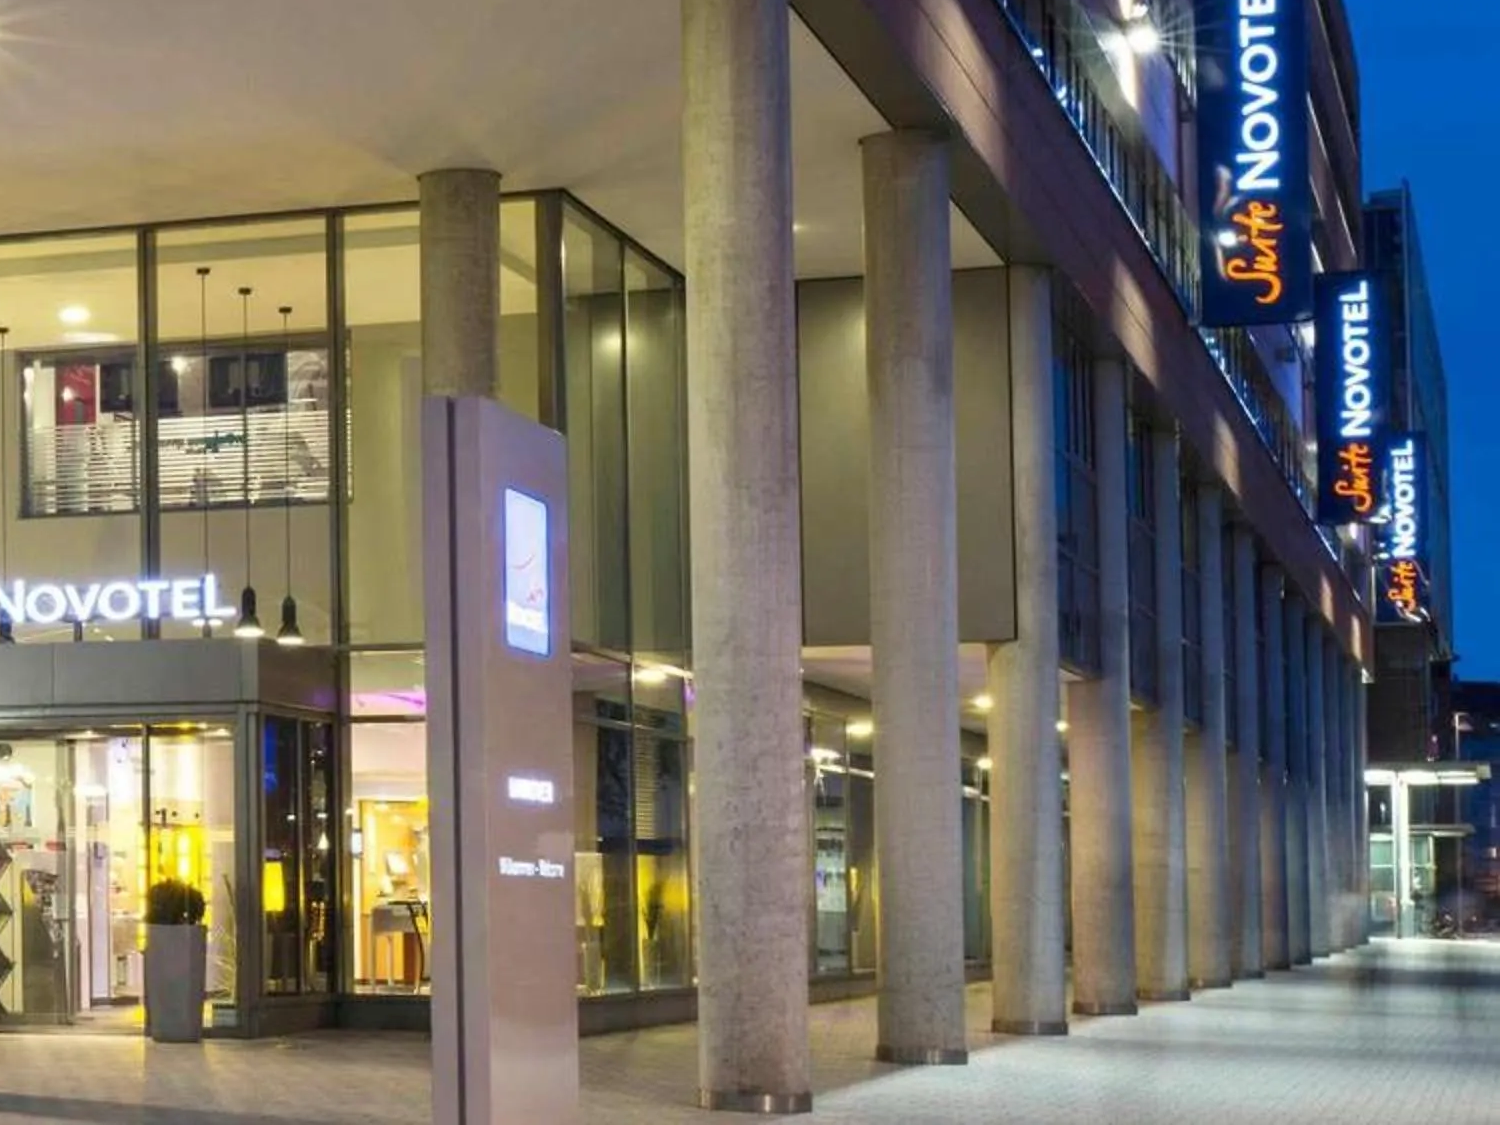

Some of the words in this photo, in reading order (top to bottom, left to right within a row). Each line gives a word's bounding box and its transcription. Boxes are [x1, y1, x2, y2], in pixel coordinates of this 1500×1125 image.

[1225, 201, 1283, 305] Suite
[1338, 280, 1371, 438] NOVOTEL
[1334, 442, 1373, 512] Suite
[1391, 439, 1416, 558] NOVOTEL
